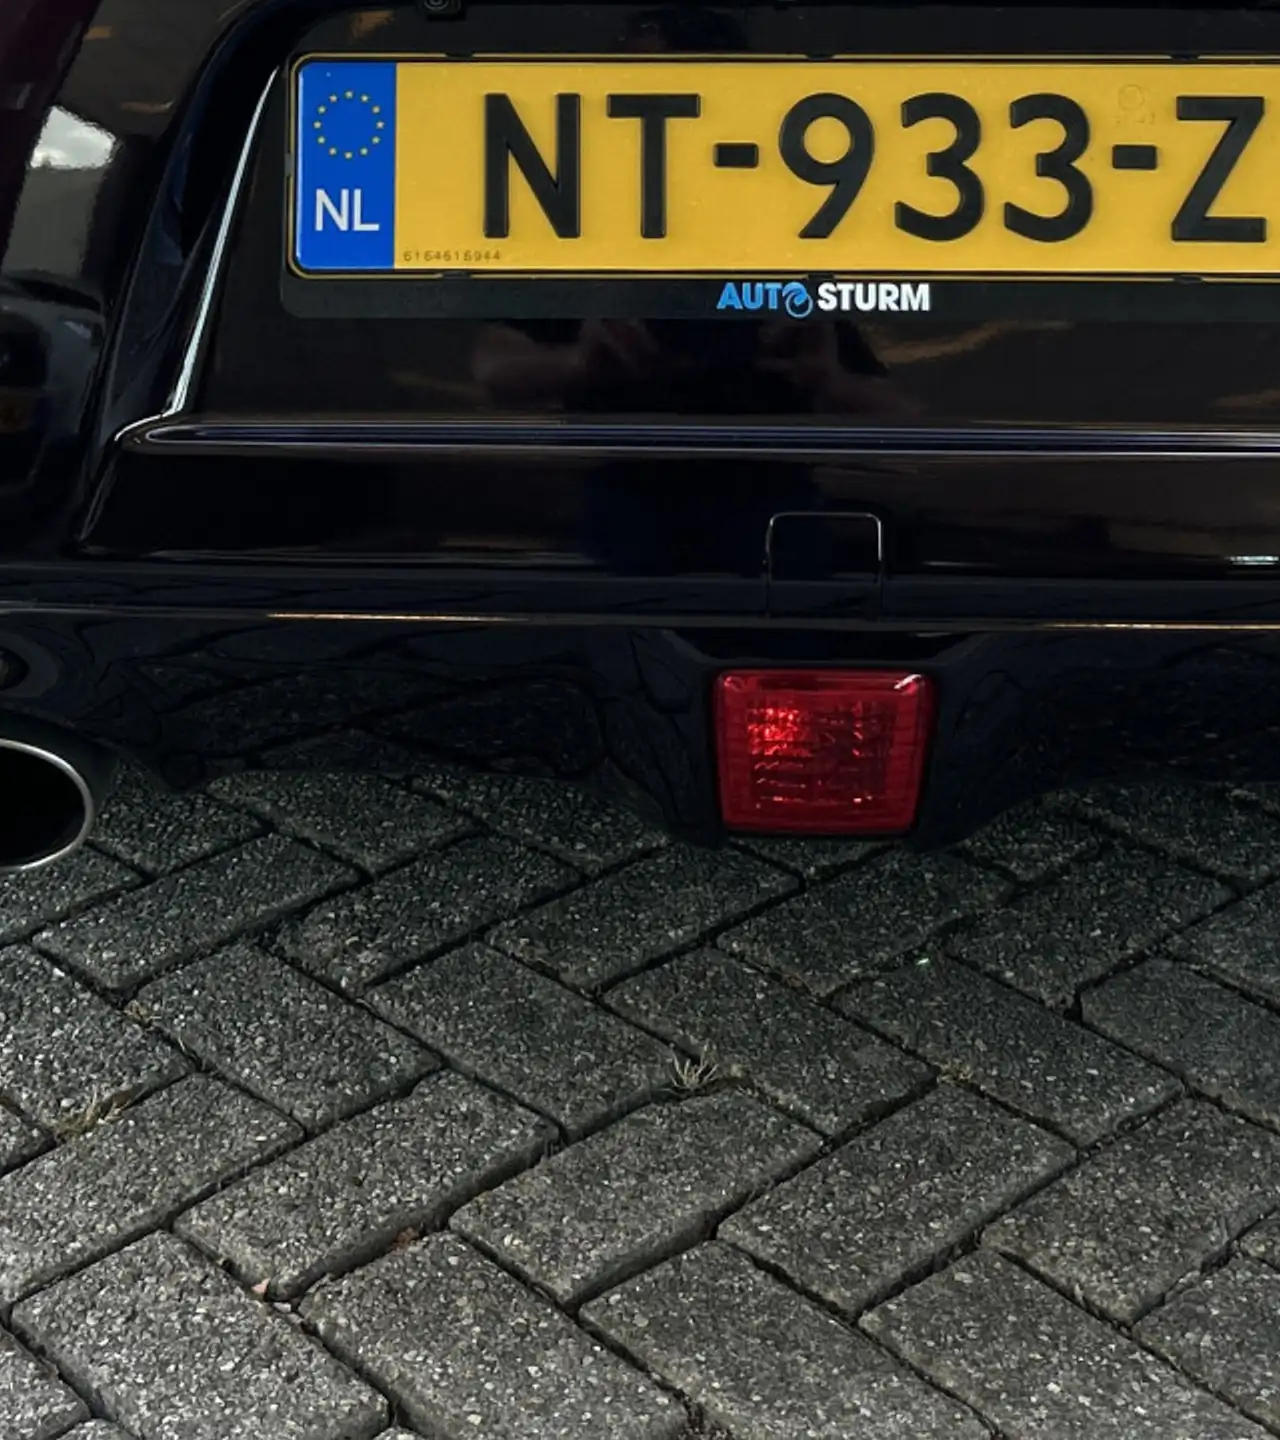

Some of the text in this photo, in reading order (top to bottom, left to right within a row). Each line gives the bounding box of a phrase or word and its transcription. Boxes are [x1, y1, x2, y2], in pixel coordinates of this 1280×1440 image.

[483, 92, 1268, 243] NT-933-Z
[314, 189, 380, 231] NL
[818, 283, 930, 311] STURM
